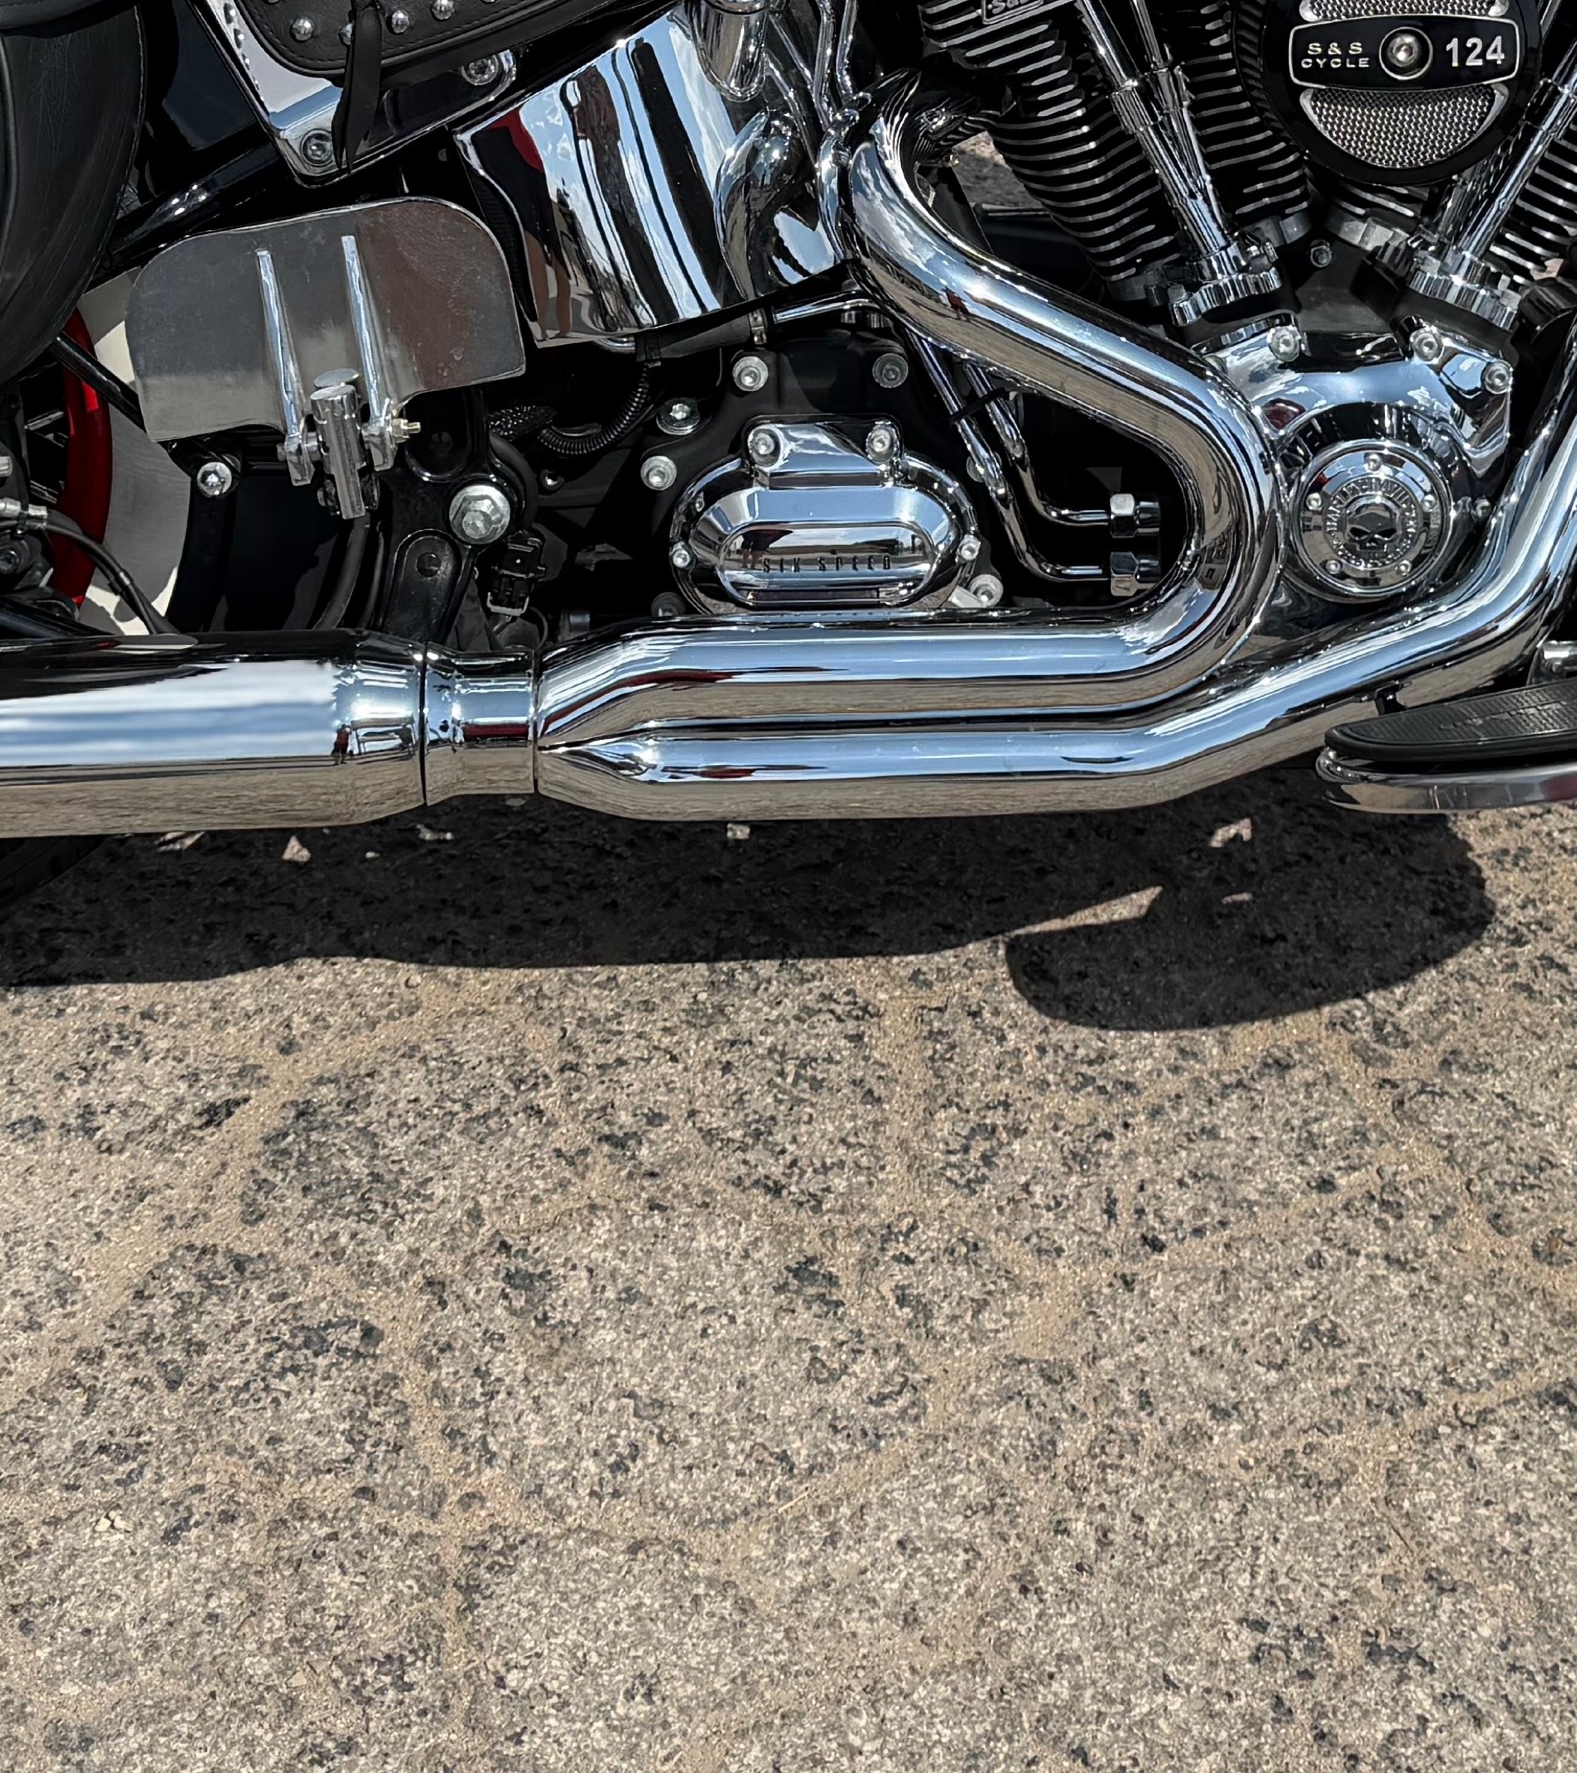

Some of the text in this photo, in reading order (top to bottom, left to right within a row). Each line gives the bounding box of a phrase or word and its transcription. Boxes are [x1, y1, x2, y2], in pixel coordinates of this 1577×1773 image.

[1445, 35, 1505, 68] 124
[1300, 57, 1371, 69] CYCLE
[817, 555, 892, 572] SPEED
